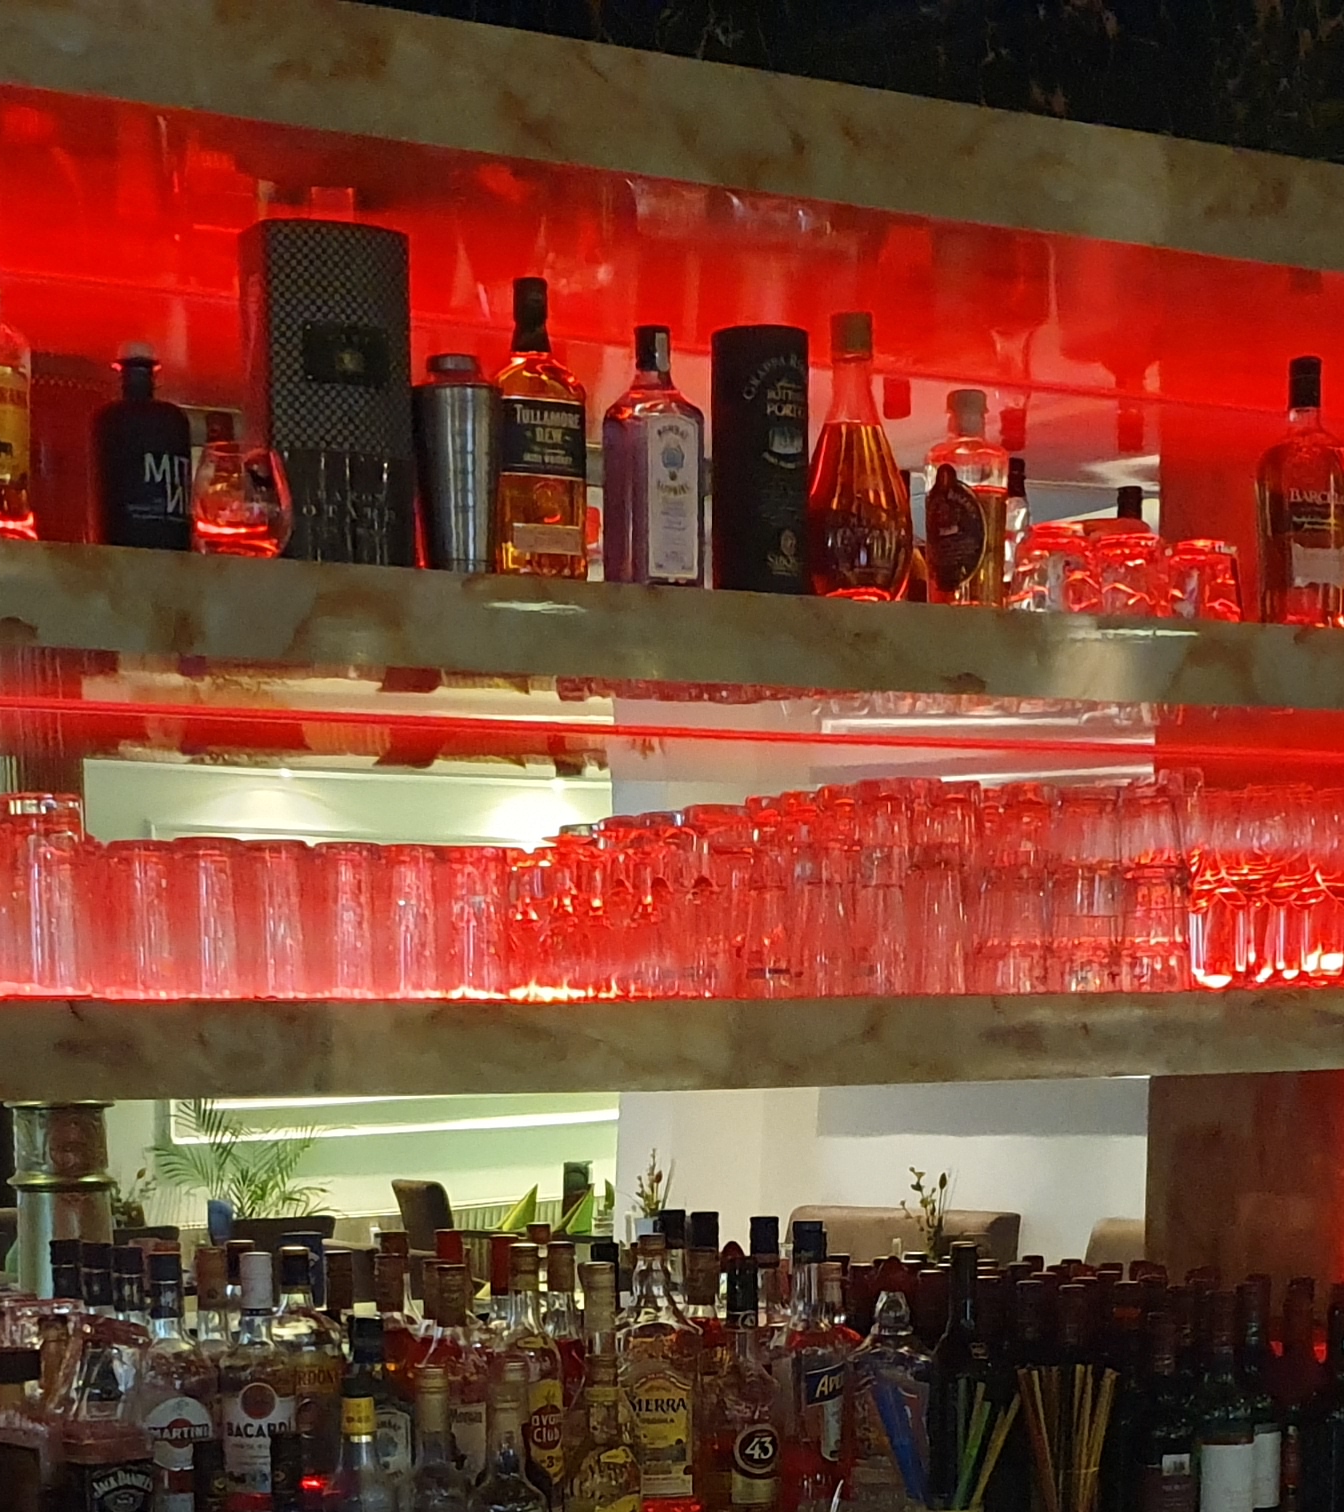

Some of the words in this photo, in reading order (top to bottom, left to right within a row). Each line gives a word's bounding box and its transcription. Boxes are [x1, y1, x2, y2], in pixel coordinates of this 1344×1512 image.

[513, 403, 582, 431] TULLAMORE
[535, 426, 564, 444] DEW
[147, 1424, 210, 1441] MARTINI
[744, 1436, 775, 1460] 43
[91, 1475, 118, 1500] JACK
